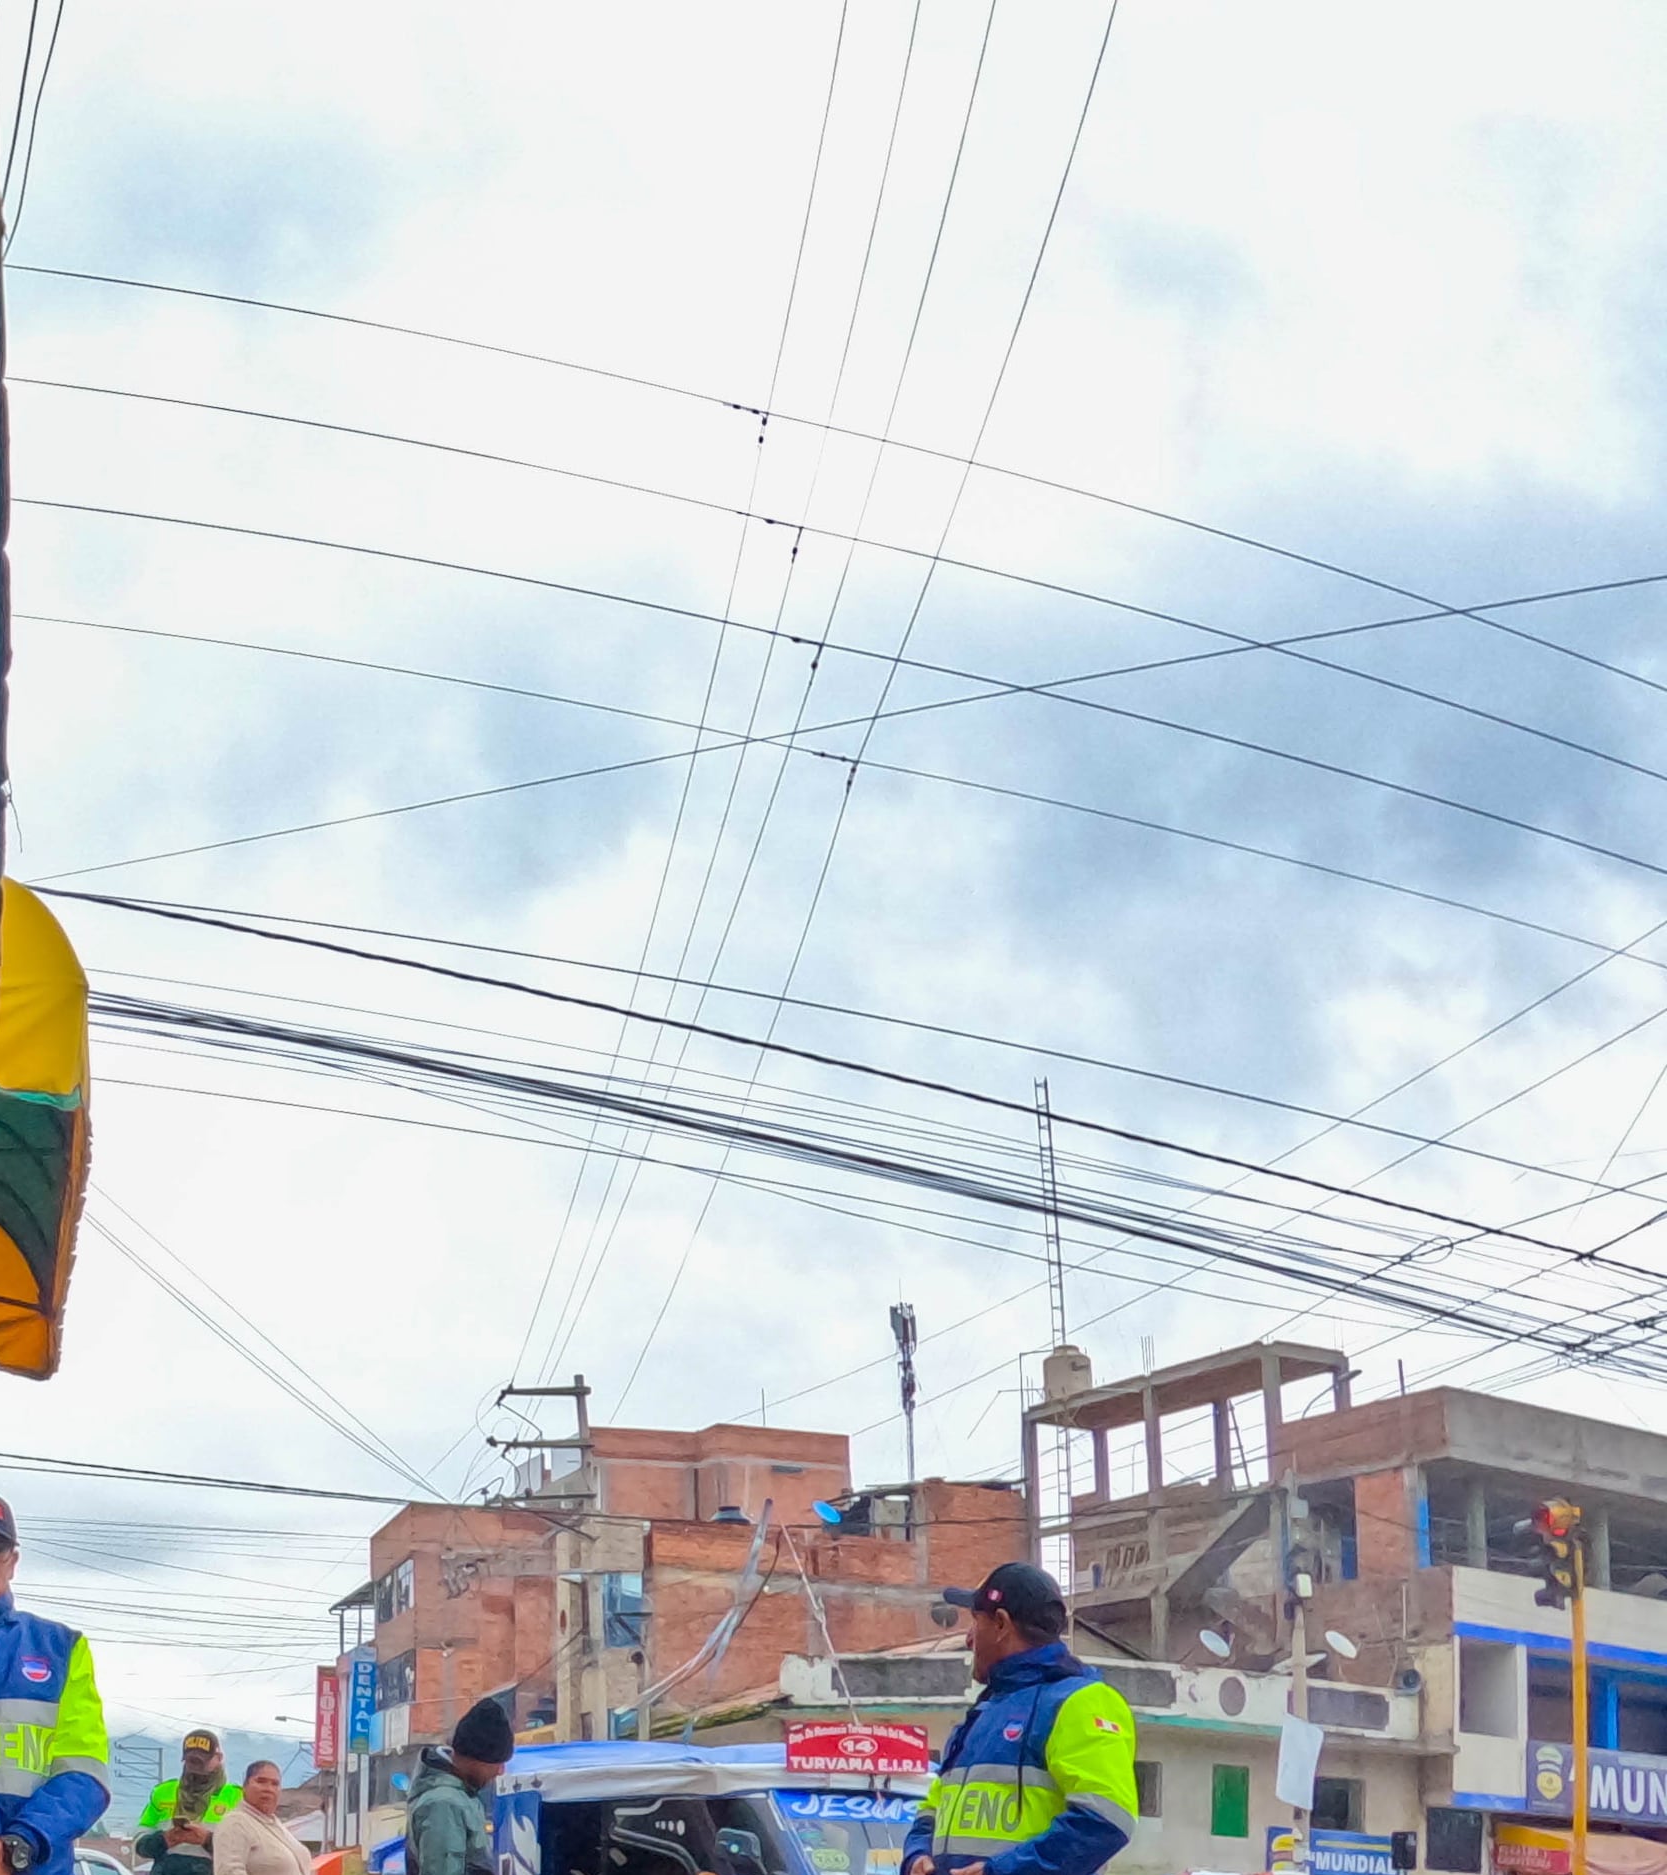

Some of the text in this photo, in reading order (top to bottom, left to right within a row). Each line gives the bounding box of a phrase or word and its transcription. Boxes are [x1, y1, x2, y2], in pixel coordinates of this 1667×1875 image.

[318, 1680, 336, 1755] LOTES
[355, 1662, 373, 1733] DENTAL
[789, 1756, 874, 1770] TURVAMA
[842, 1740, 874, 1753] 14
